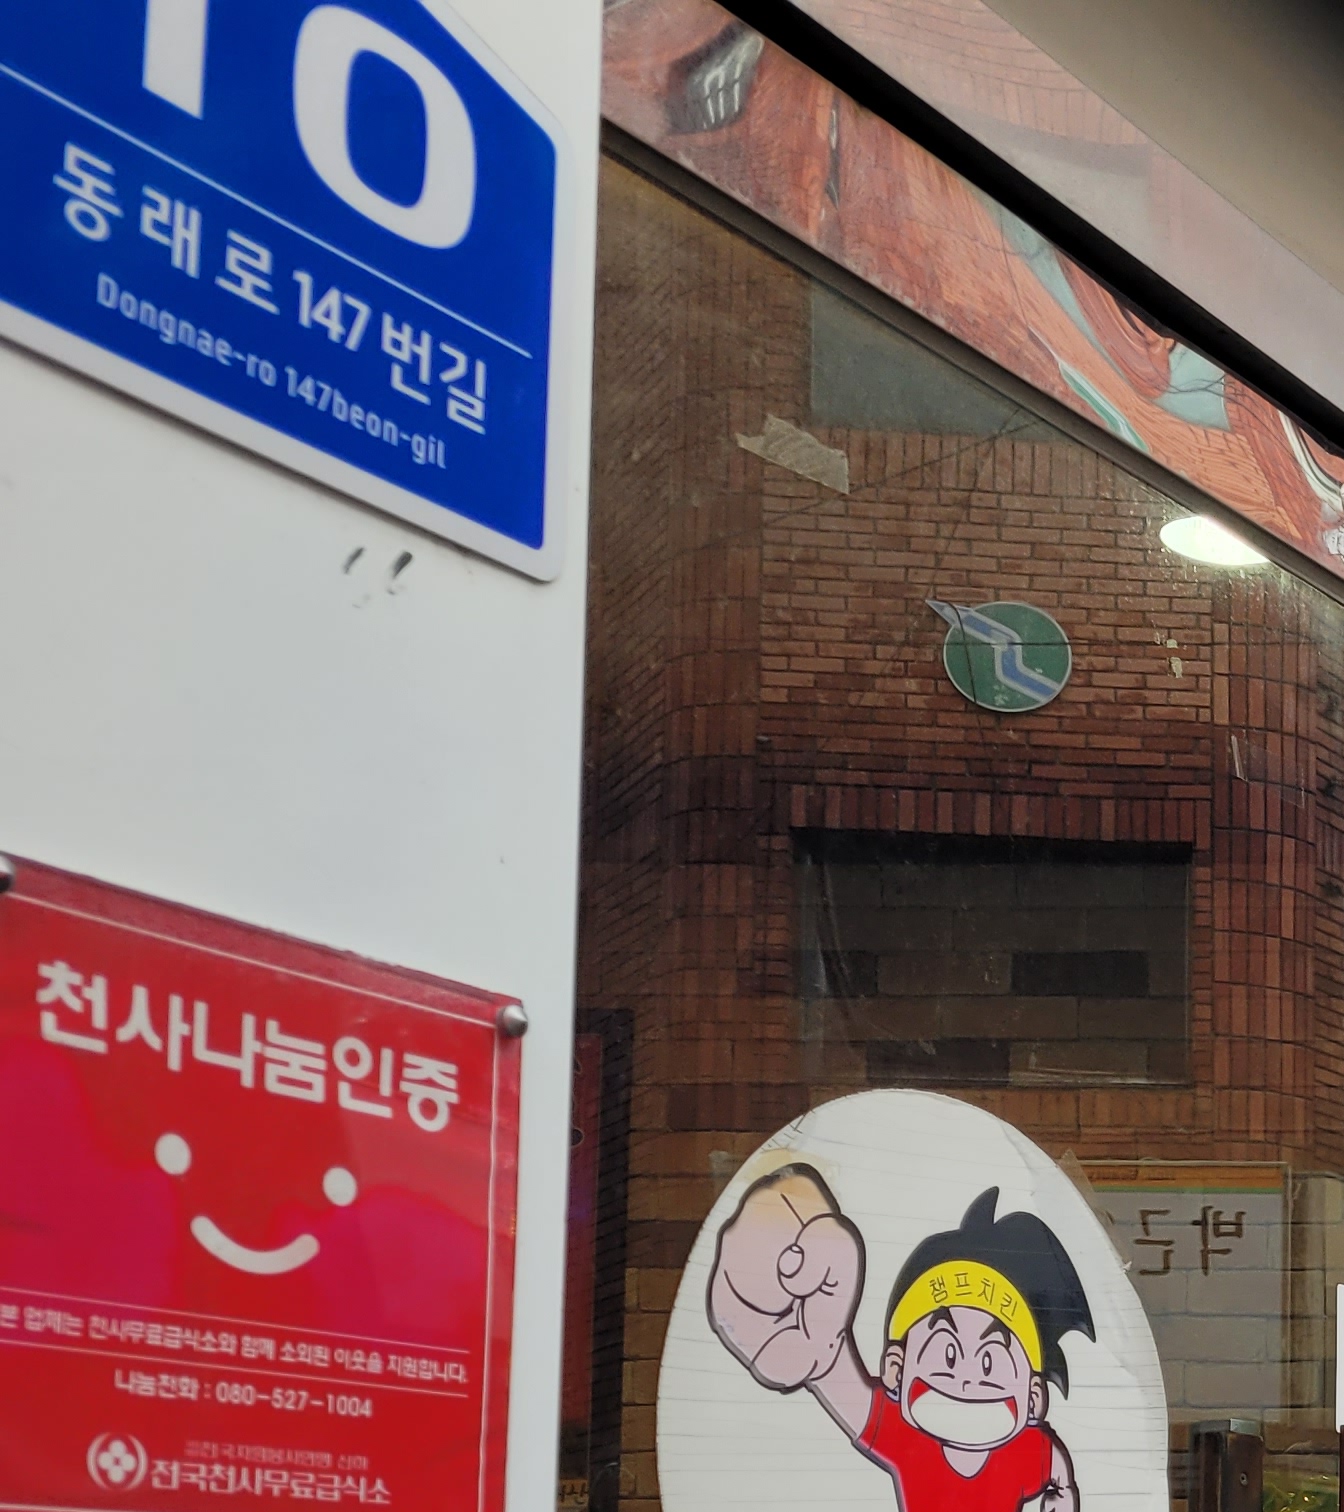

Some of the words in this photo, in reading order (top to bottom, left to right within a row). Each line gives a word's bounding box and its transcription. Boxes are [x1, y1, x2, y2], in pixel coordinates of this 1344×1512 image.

[142, 0, 476, 250] 10
[97, 272, 277, 387] Dongnae-ro
[283, 366, 447, 469] 147beon-gil
[37, 959, 461, 1132] 천사나눔인증
[927, 1269, 1020, 1324] 챔프치킨
[23, 1305, 84, 1336] 업체는
[88, 1314, 239, 1356] 천사무료급식소와
[240, 1335, 276, 1362] 함께
[279, 1340, 331, 1368] 소외된
[334, 1347, 384, 1375] 이웃을
[386, 1353, 469, 1384] 지원합니다.
[113, 1368, 200, 1402] 나눔전화
[215, 1381, 373, 1418] 080-527-1004
[150, 1459, 392, 1506] 전국천사무료급식소
